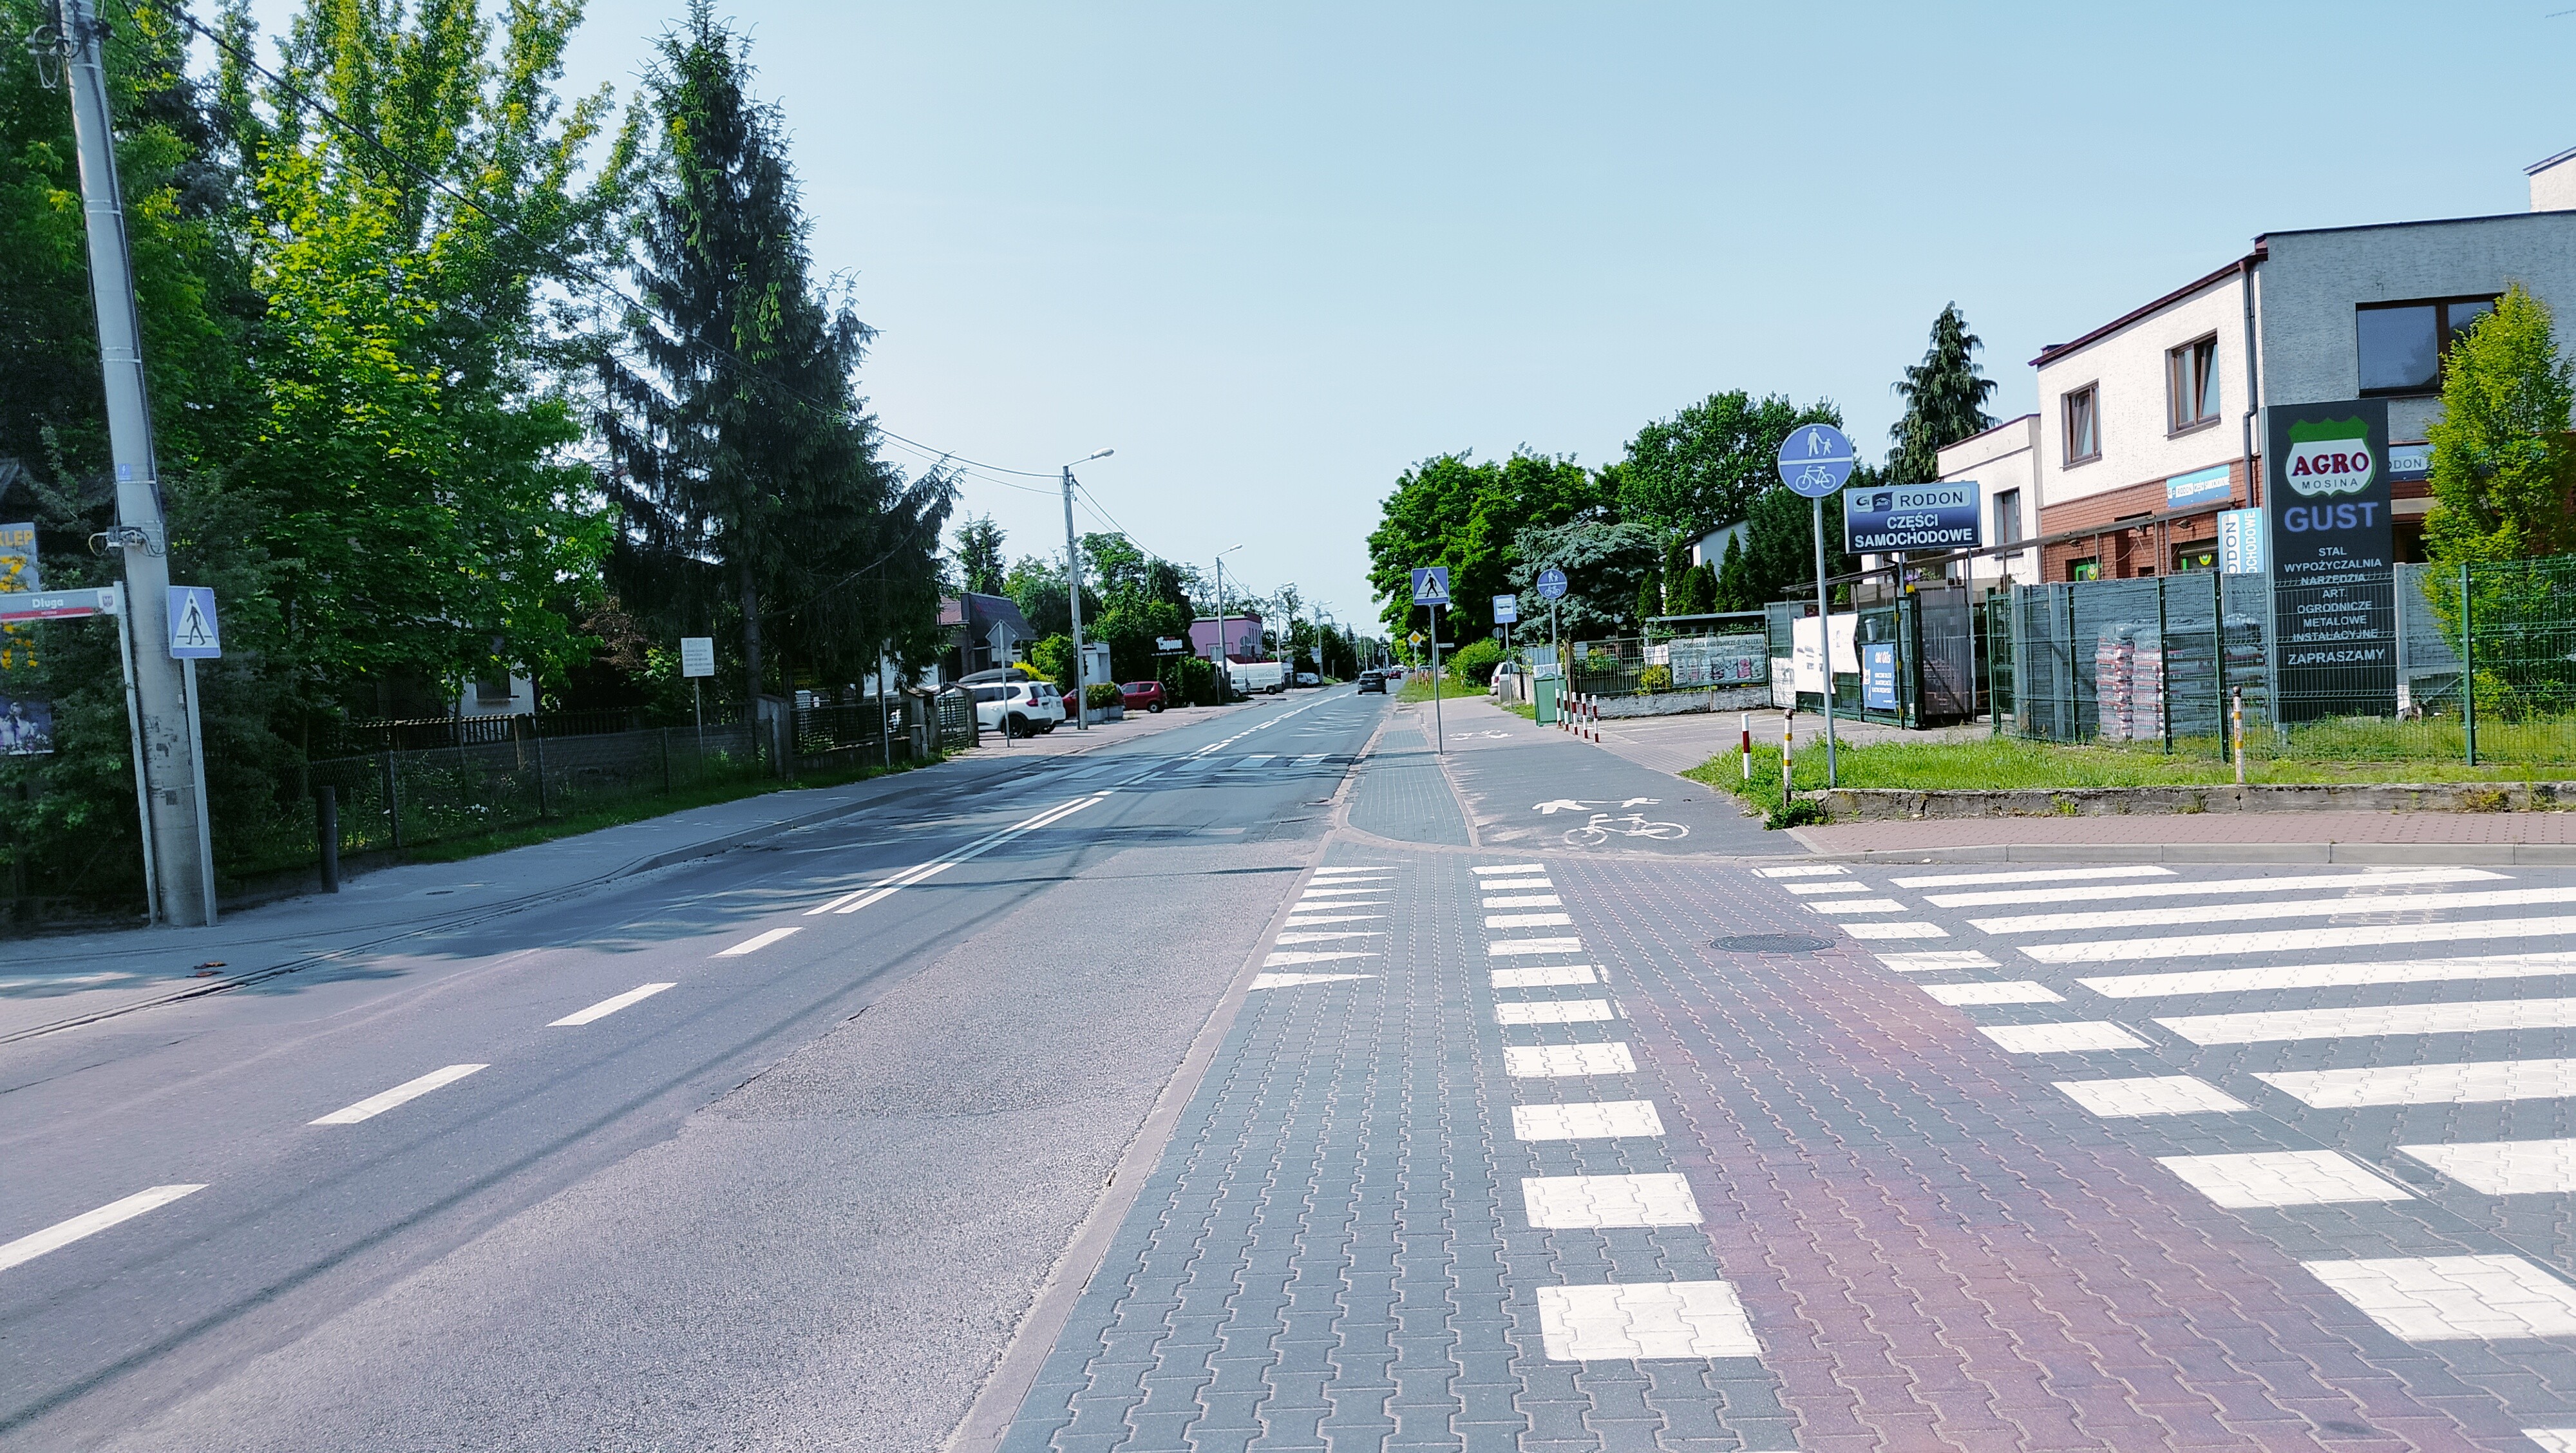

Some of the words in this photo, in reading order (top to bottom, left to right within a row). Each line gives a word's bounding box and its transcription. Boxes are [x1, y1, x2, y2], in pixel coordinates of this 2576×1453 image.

[2291, 451, 2369, 477] AGRO
[2302, 478, 2358, 489] MOSINA
[1900, 491, 1963, 508] RODON
[1886, 511, 1938, 531] CZĘŚCI
[2284, 502, 2378, 533] GUST
[1854, 528, 1973, 548] SAMOCHODOWE
[2318, 546, 2347, 556] STAL
[2284, 558, 2382, 573] WYPOŻYCZALNIA
[2300, 573, 2366, 585] NARZĘDZIA
[2322, 588, 2347, 598] ART.
[2297, 600, 2372, 614] OGRODNICZE
[2303, 614, 2367, 627] METALOWE
[2293, 628, 2378, 642] INSTALACYJNE
[2287, 648, 2385, 665] ZAPRASZAMY
